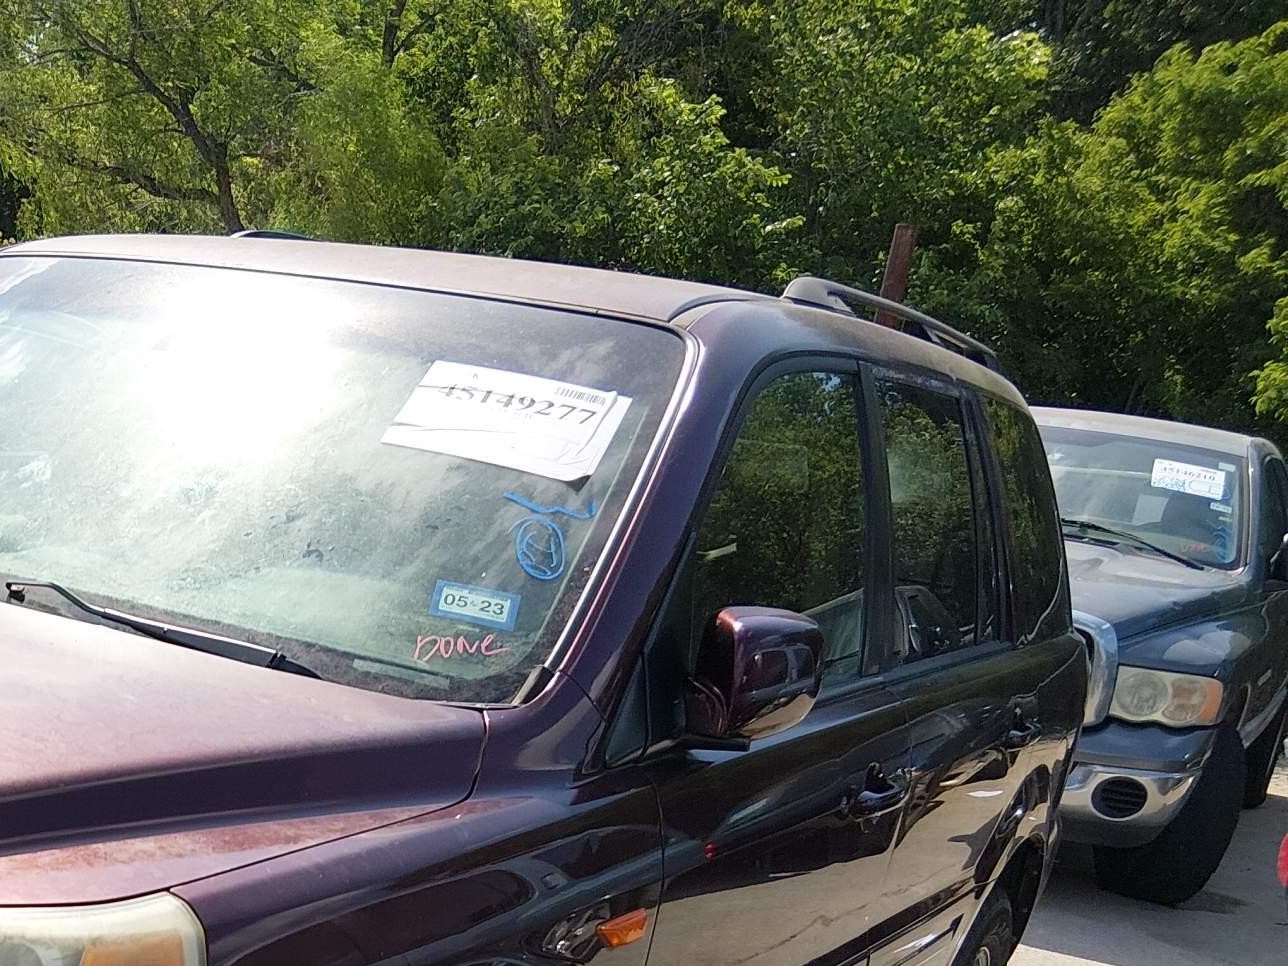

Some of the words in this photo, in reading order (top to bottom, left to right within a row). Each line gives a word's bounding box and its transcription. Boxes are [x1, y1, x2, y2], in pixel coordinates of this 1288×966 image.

[438, 384, 597, 424] 45149277
[444, 593, 468, 608] 05
[479, 600, 505, 615] 23
